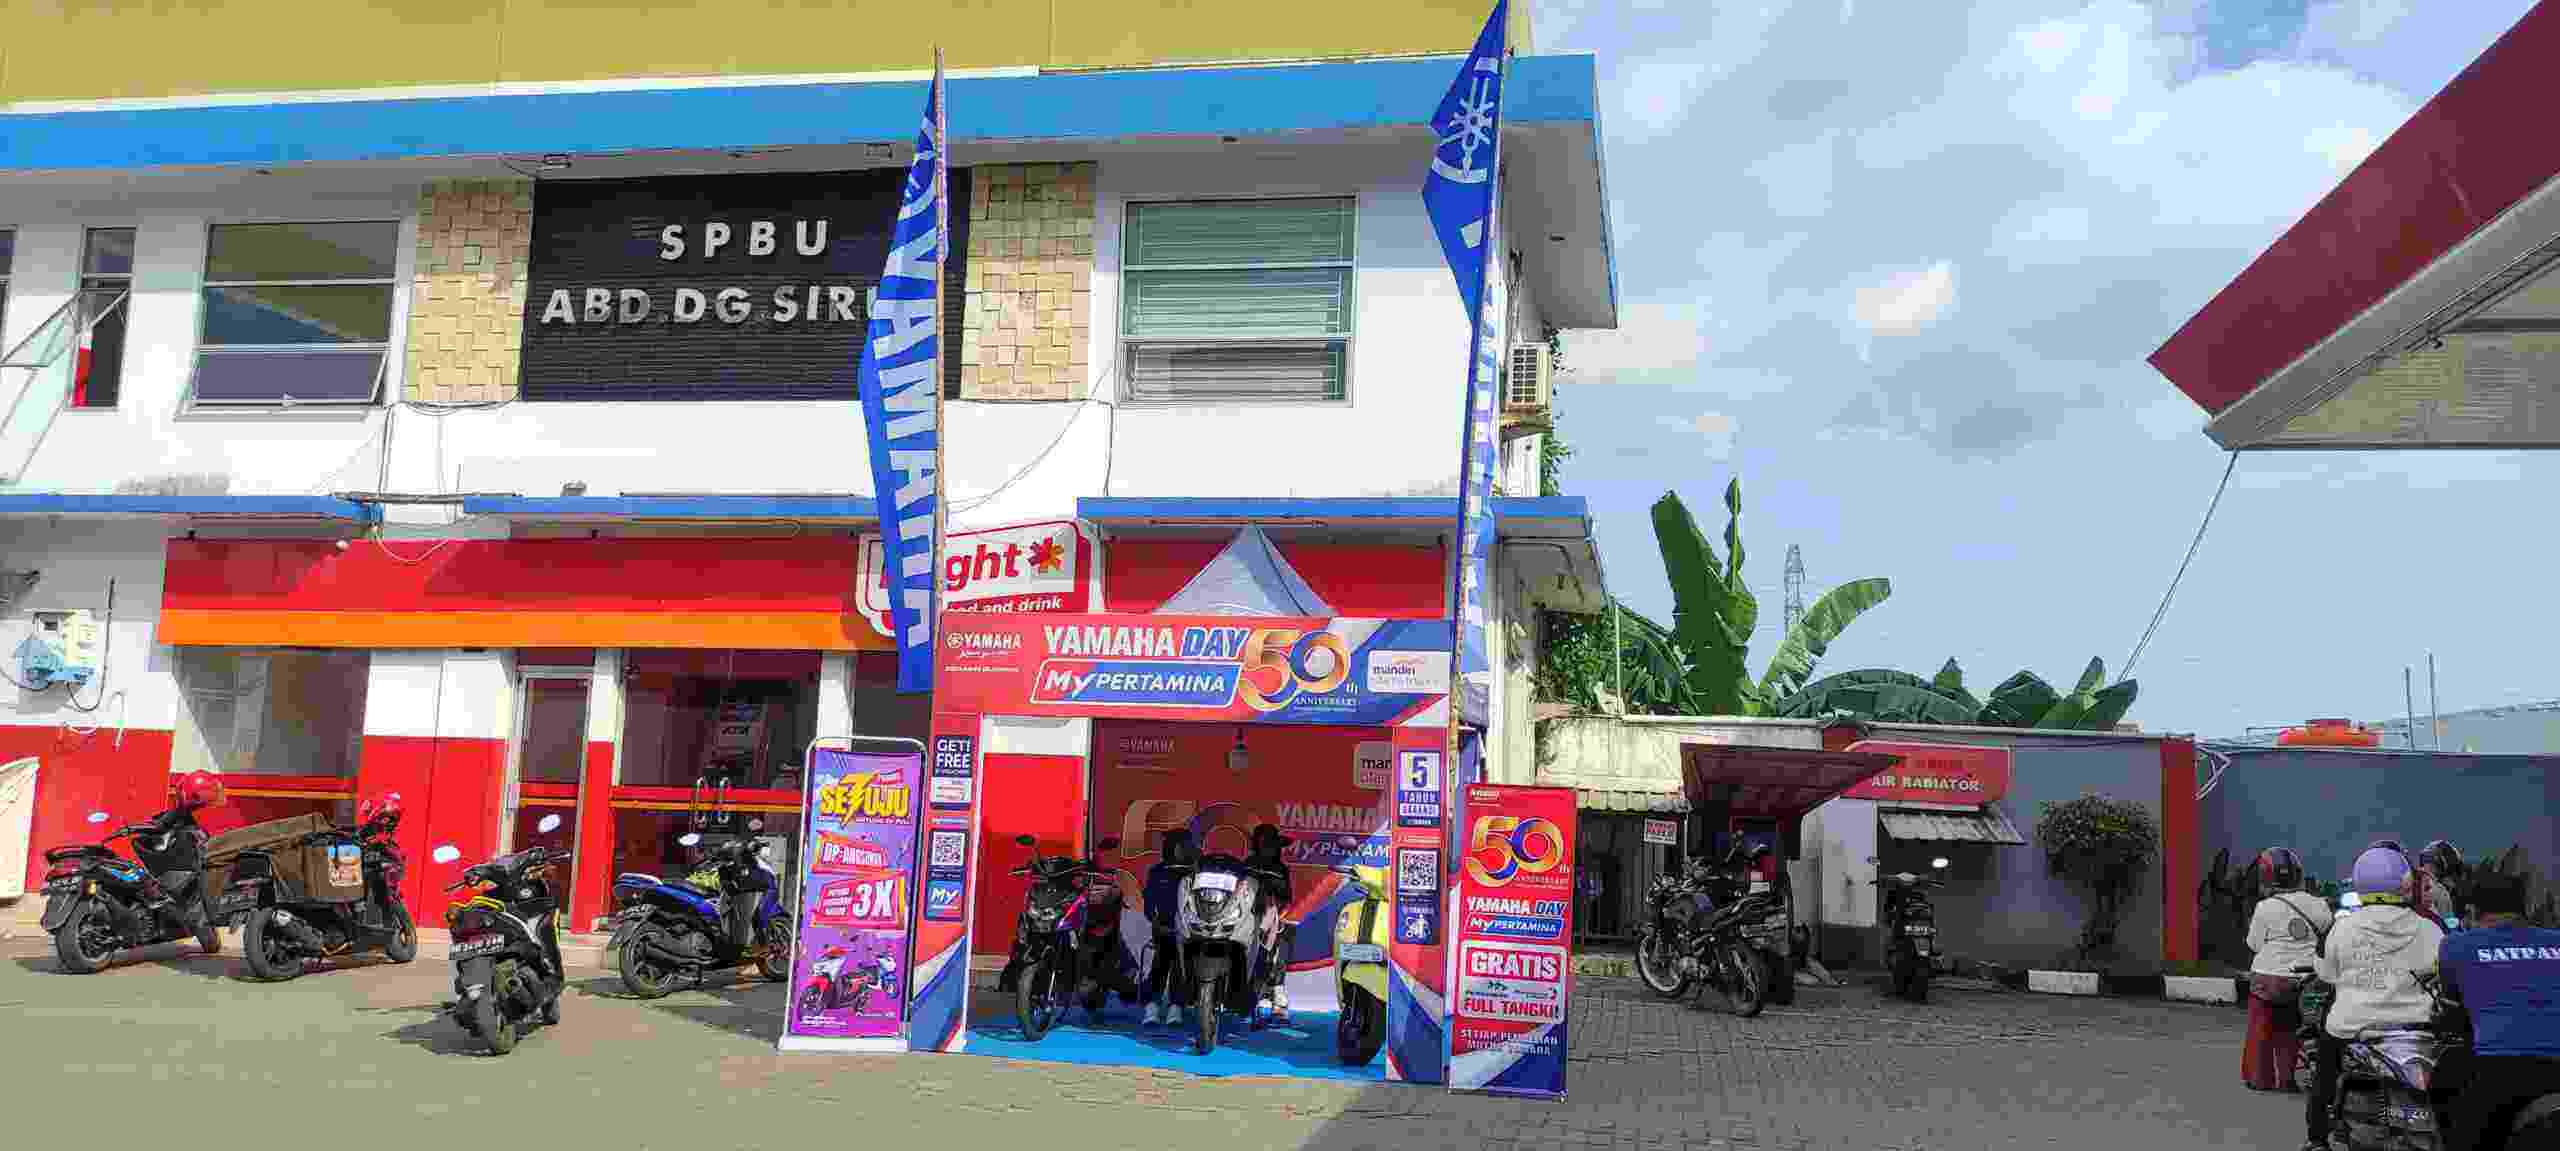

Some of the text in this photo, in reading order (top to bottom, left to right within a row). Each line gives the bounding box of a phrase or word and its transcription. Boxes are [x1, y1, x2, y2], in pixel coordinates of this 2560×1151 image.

[659, 219, 828, 261] SPBU
[867, 226, 938, 648] YAMAHA
[1018, 595, 1064, 612] drink
[963, 633, 1023, 649] YAMAHA
[1043, 624, 1251, 658] YAMAHA DAY
[1239, 628, 1351, 712] 50
[936, 752, 971, 769] FREE
[1411, 755, 1428, 788] 5
[1403, 791, 1437, 803] TAHUN
[1871, 775, 1980, 792] AIR RADIATOR
[1278, 801, 1378, 830] YAMAHA
[1464, 815, 1564, 888] 50
[853, 880, 895, 918] 3X
[1466, 896, 1569, 915] YAMAHA DAY
[1471, 951, 1558, 981] GRATIS
[1465, 998, 1497, 1014] FULL
